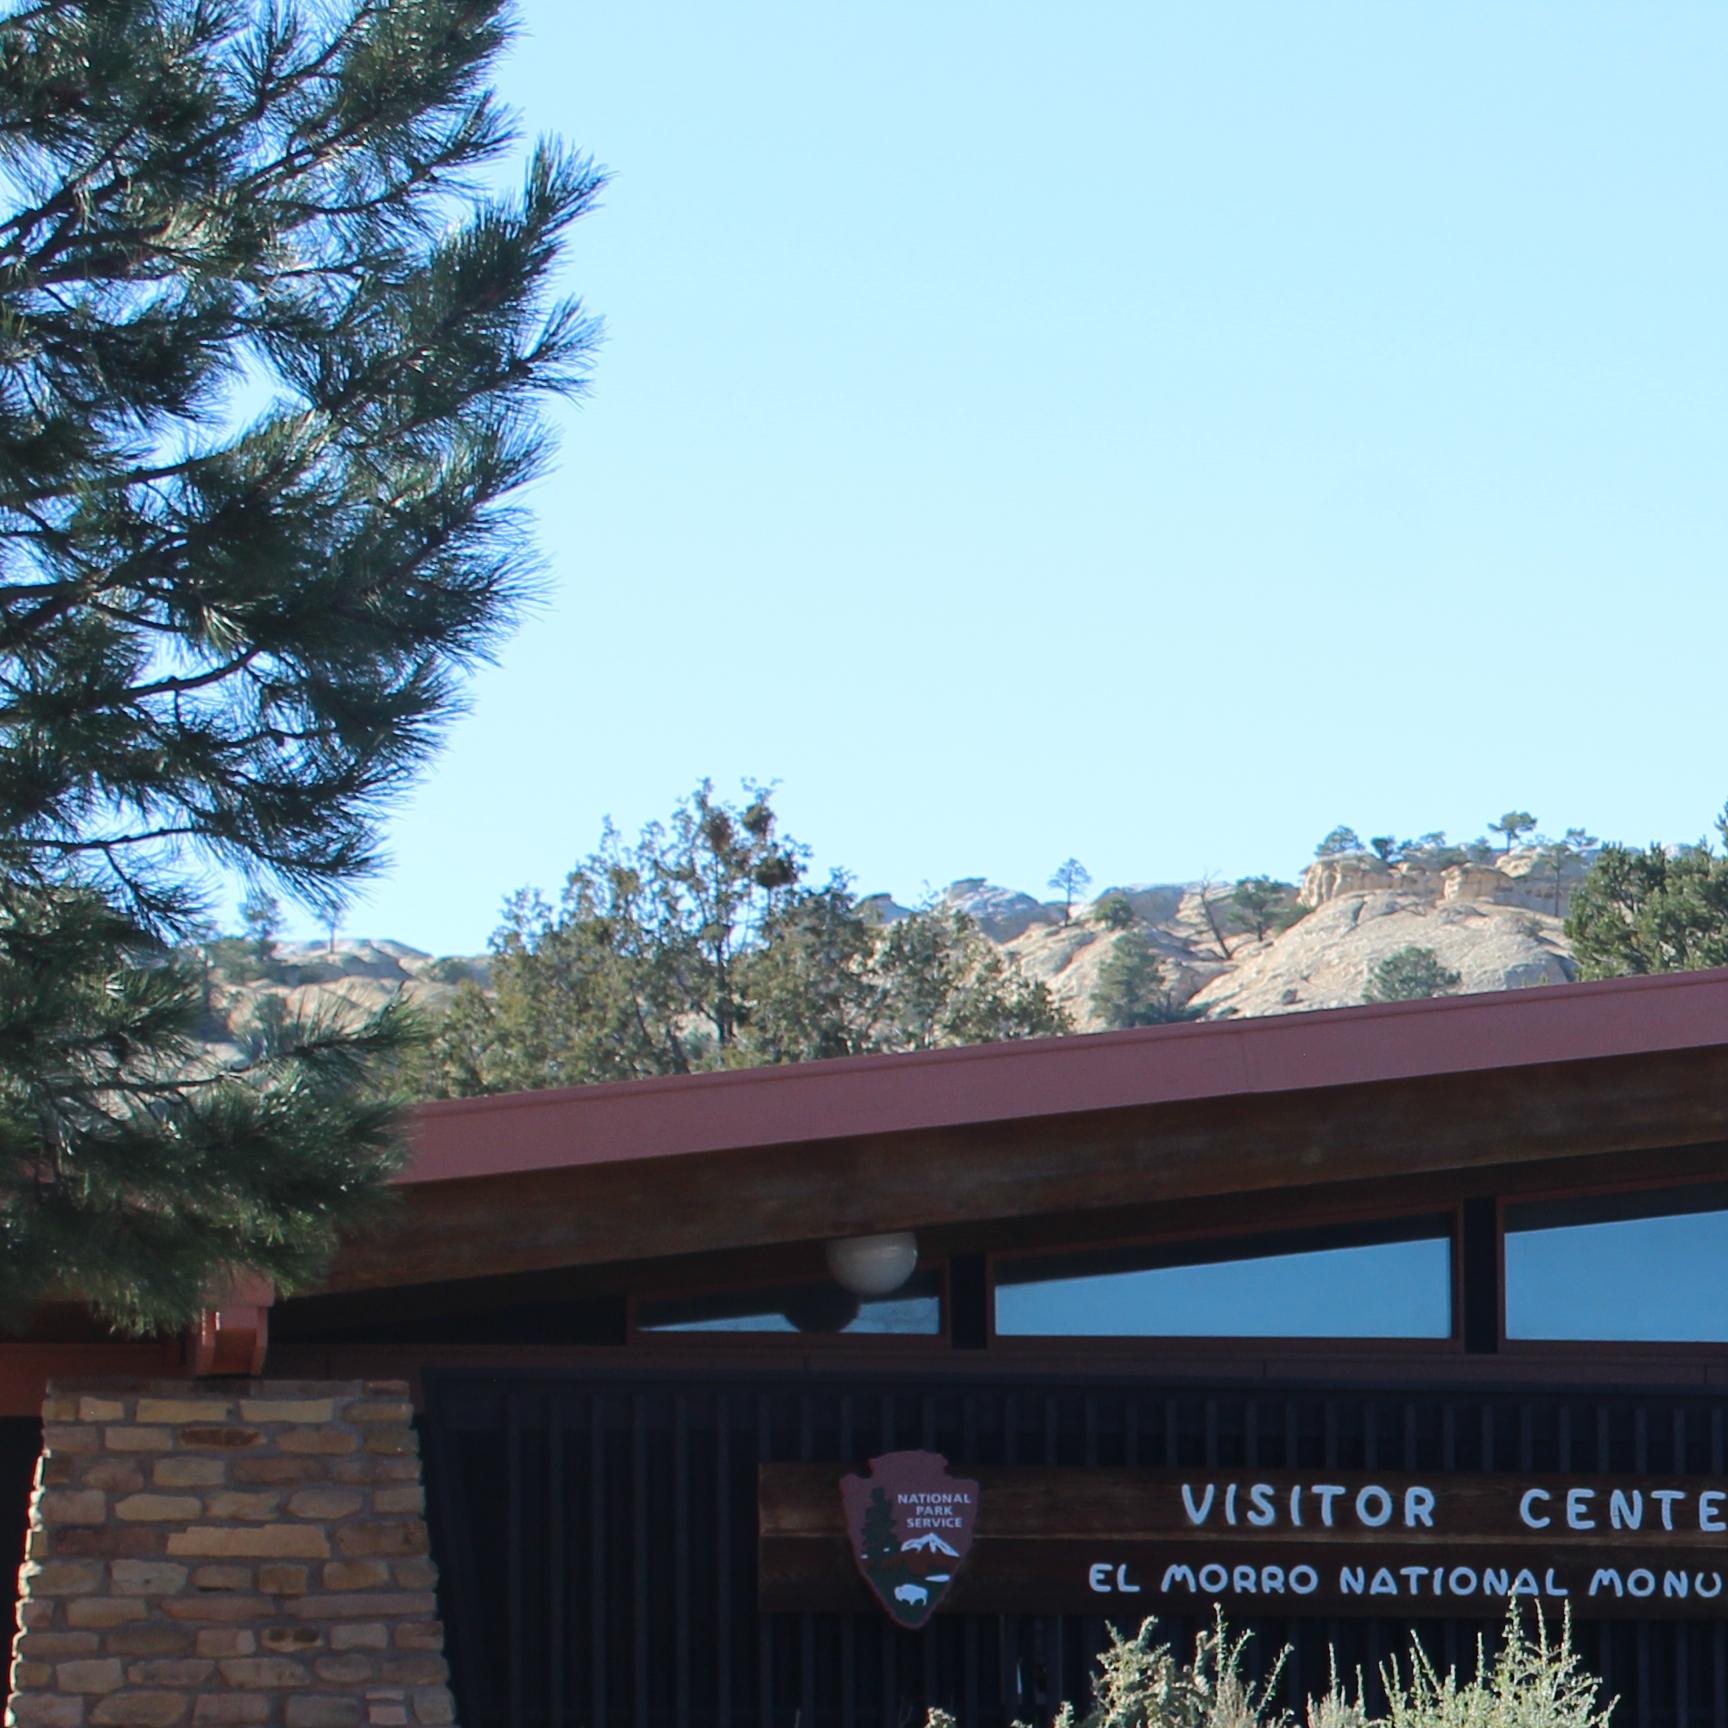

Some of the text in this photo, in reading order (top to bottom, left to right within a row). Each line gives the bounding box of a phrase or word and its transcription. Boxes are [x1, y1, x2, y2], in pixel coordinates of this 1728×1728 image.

[897, 1493, 971, 1504] NATIONAL
[915, 1505, 953, 1516] PARK
[1181, 1483, 1435, 1528] VISITOR
[906, 1517, 962, 1528] SERVICE
[1088, 1563, 1141, 1593] EL
[1160, 1563, 1319, 1595] MORRO
[1340, 1566, 1569, 1597] NATIONAL
